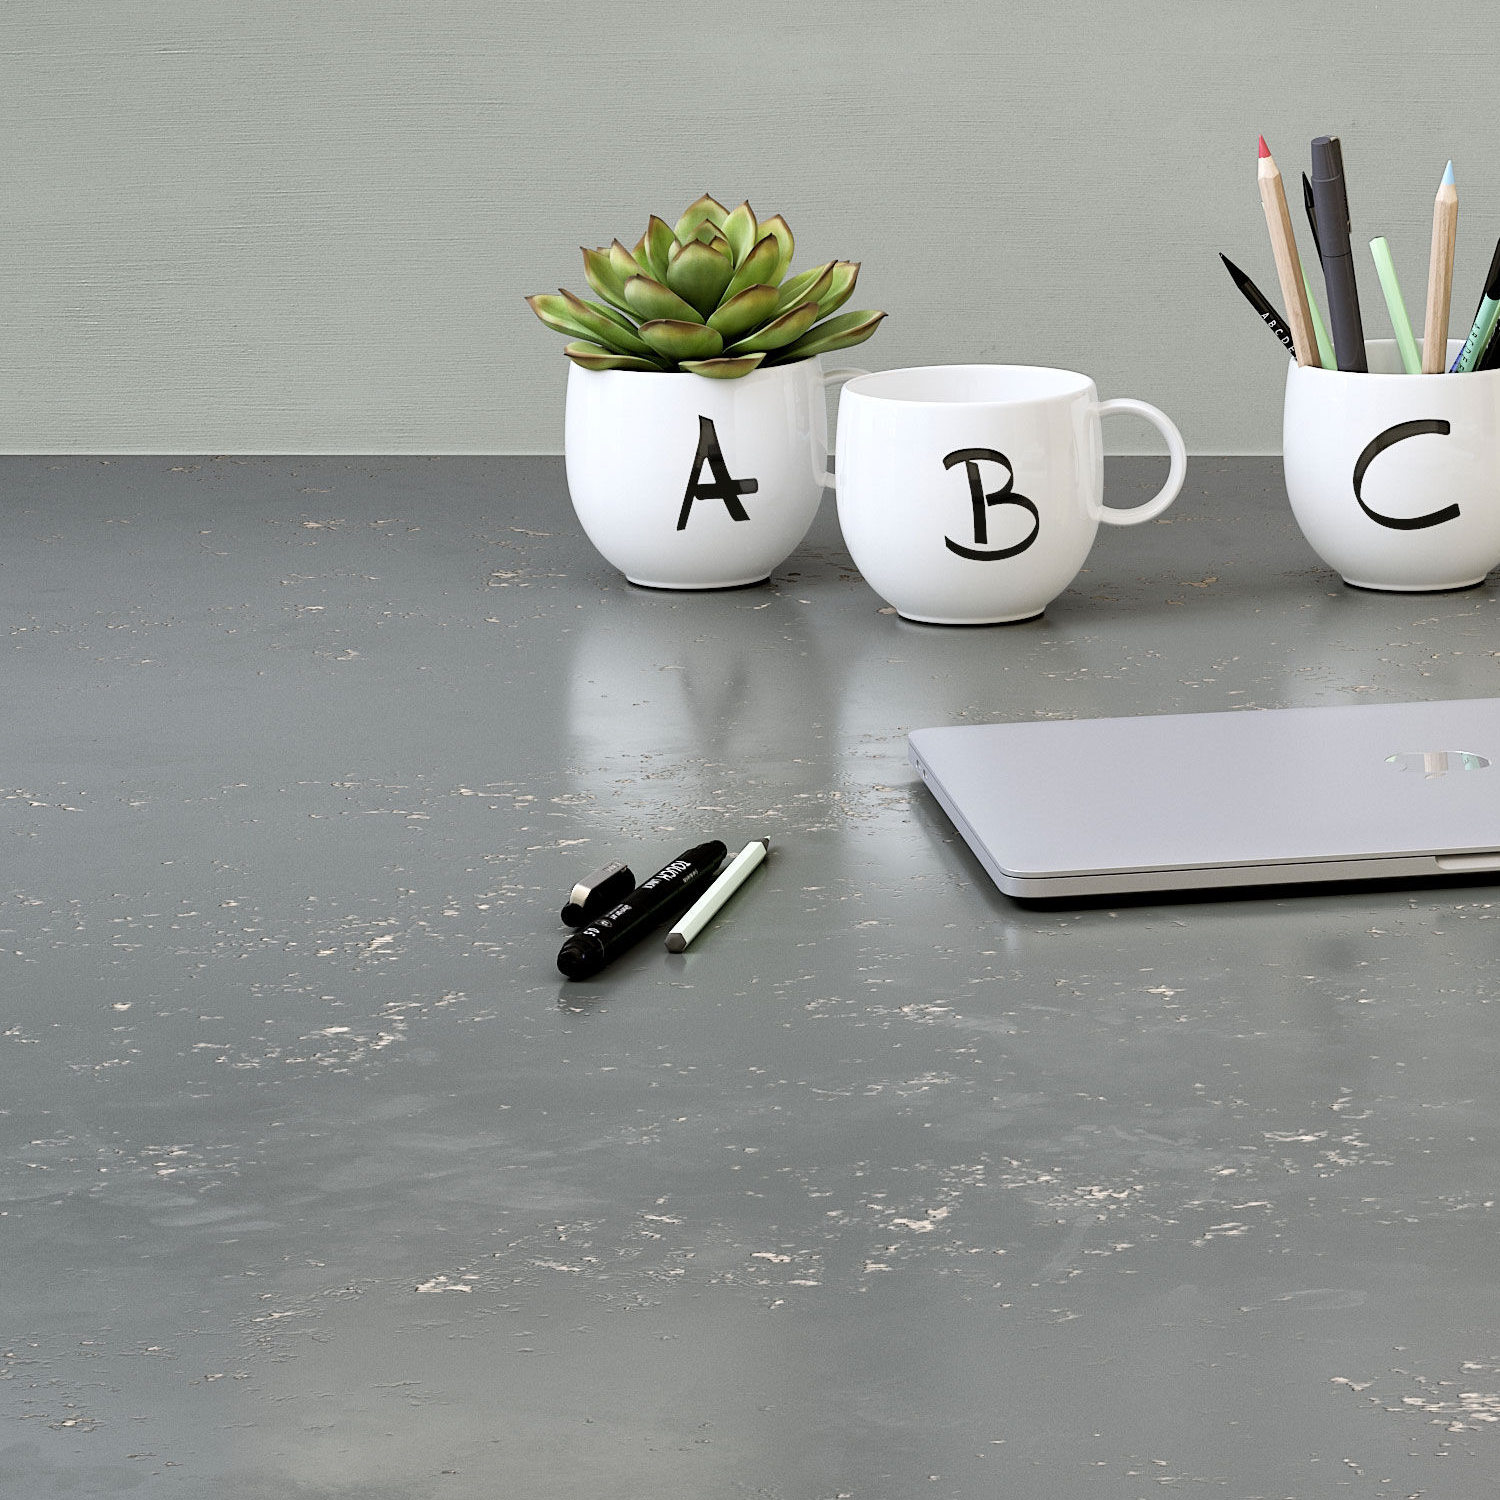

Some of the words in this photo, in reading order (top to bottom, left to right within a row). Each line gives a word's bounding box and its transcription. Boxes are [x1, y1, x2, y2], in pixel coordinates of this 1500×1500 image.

[677, 415, 758, 531] A
[943, 448, 1039, 561] B
[1353, 419, 1460, 530] C
